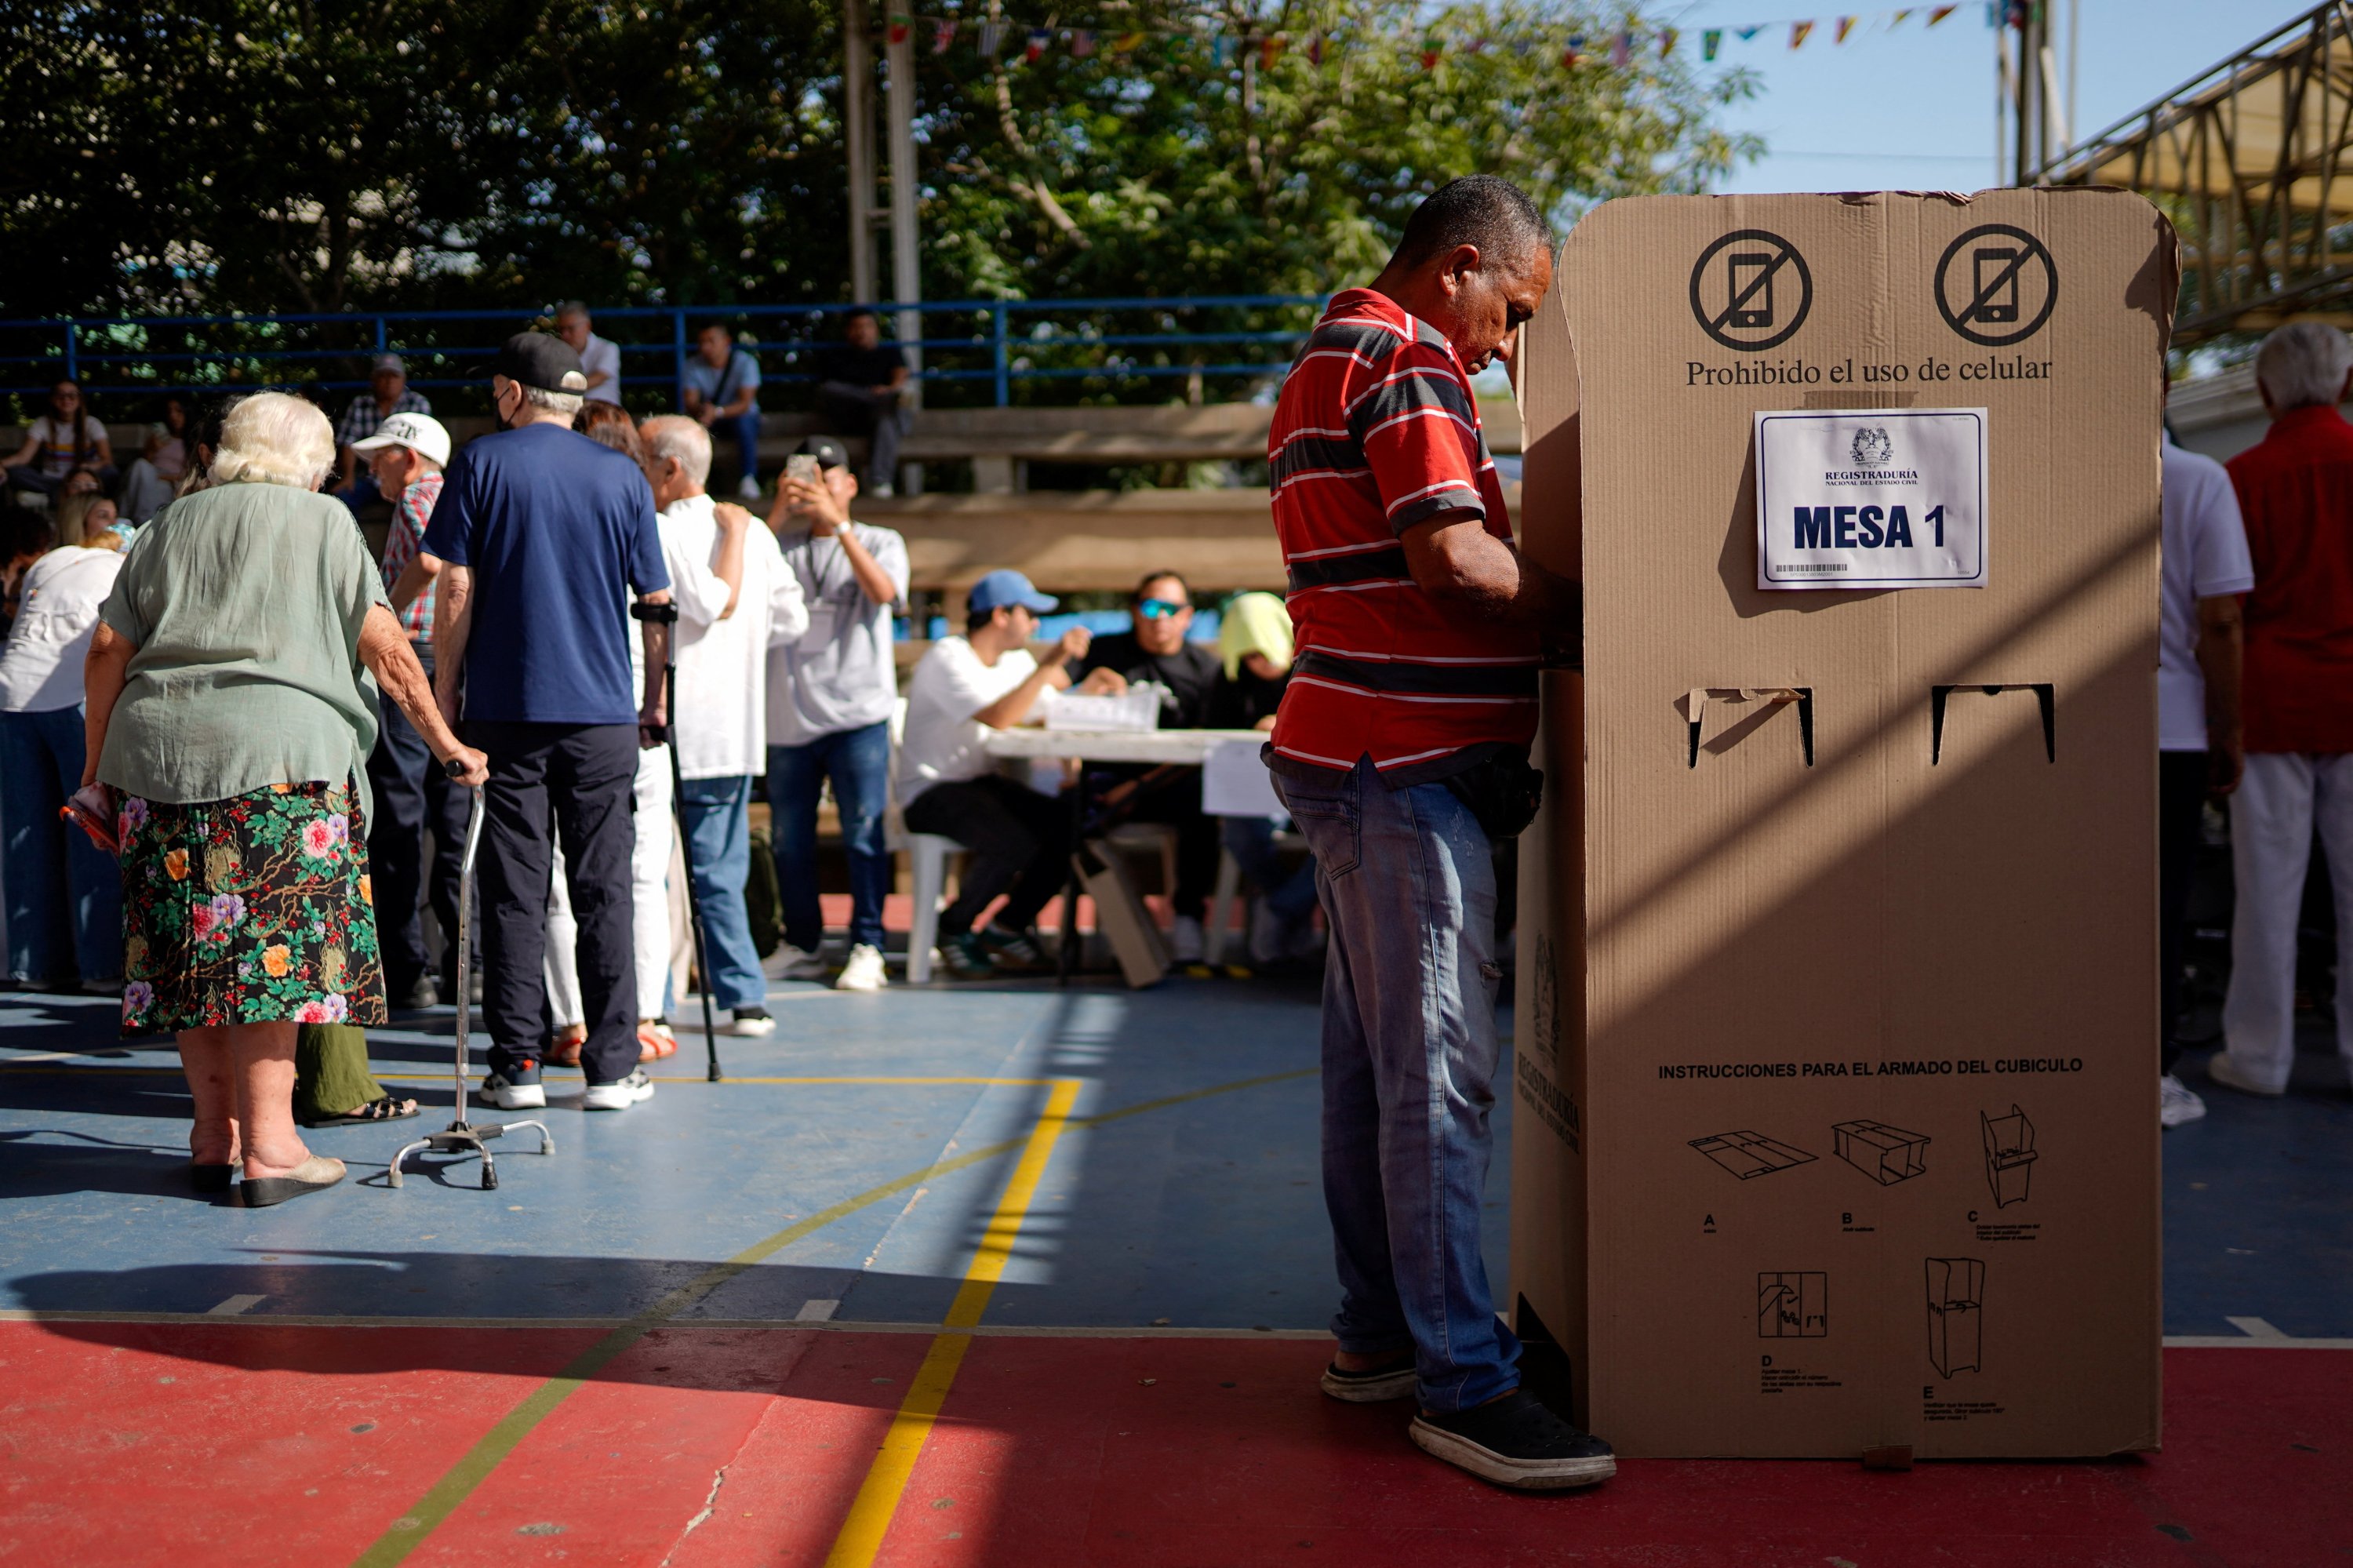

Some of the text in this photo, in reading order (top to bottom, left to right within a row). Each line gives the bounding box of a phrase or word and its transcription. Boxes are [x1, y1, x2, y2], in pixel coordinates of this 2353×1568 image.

[1686, 355, 2053, 386] Prohibido el uso de celular
[1825, 467, 1918, 480] REGISTRADURÍA
[1794, 504, 1944, 549] MESA 1
[1659, 1057, 2083, 1079] INSTRUCCIONES PARA EL ARMADO DEL CUBICULO
[1518, 1052, 1580, 1133] REGISTRADURÍA
[1704, 1214, 1715, 1226] A
[1842, 1213, 1853, 1224] B
[1968, 1210, 1978, 1223] C
[1762, 1355, 1773, 1367] D
[1923, 1385, 1934, 1399] E
